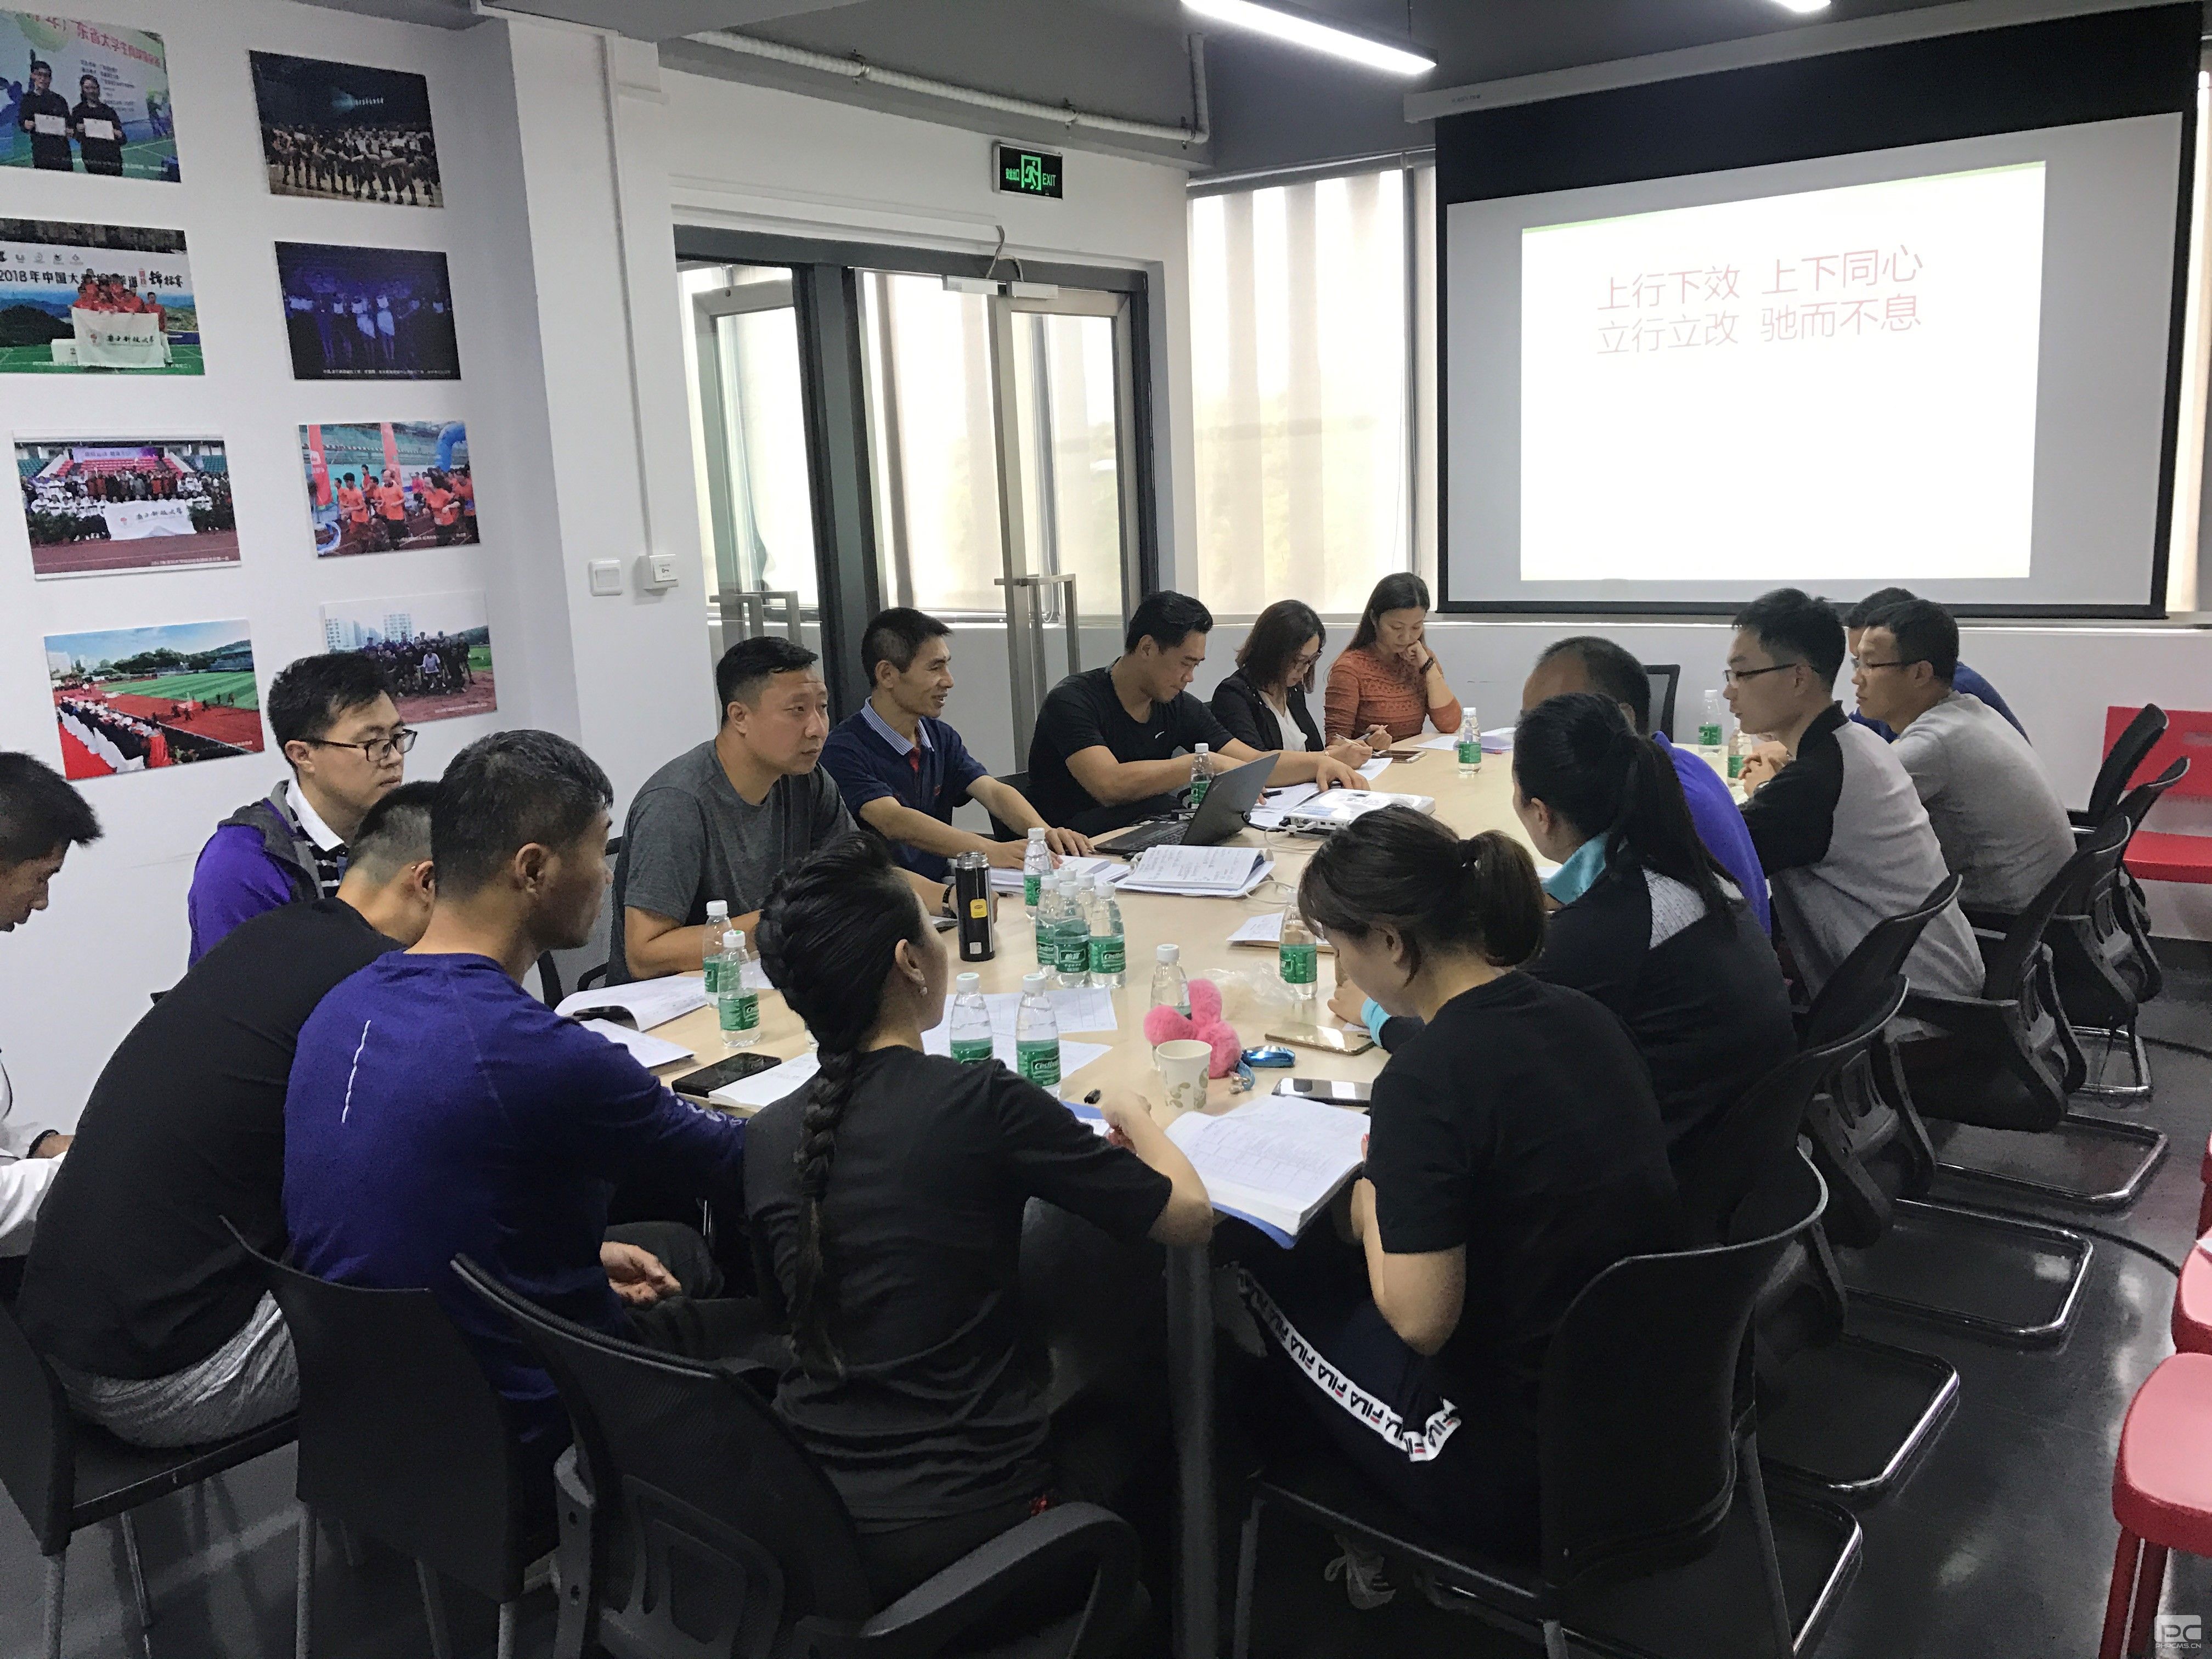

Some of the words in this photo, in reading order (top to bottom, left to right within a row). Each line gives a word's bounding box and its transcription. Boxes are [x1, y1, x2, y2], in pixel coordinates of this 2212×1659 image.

[1042, 173, 1057, 186] EXIT
[1597, 264, 1740, 311] 上行下效
[1761, 244, 1922, 294] 上下同心
[1597, 310, 1739, 354] 立行立改
[1760, 293, 1921, 342] 驰而不息
[1290, 1334, 1316, 1370] FILA
[1318, 1363, 1347, 1398] FILA
[1350, 1390, 1384, 1425] FILA
